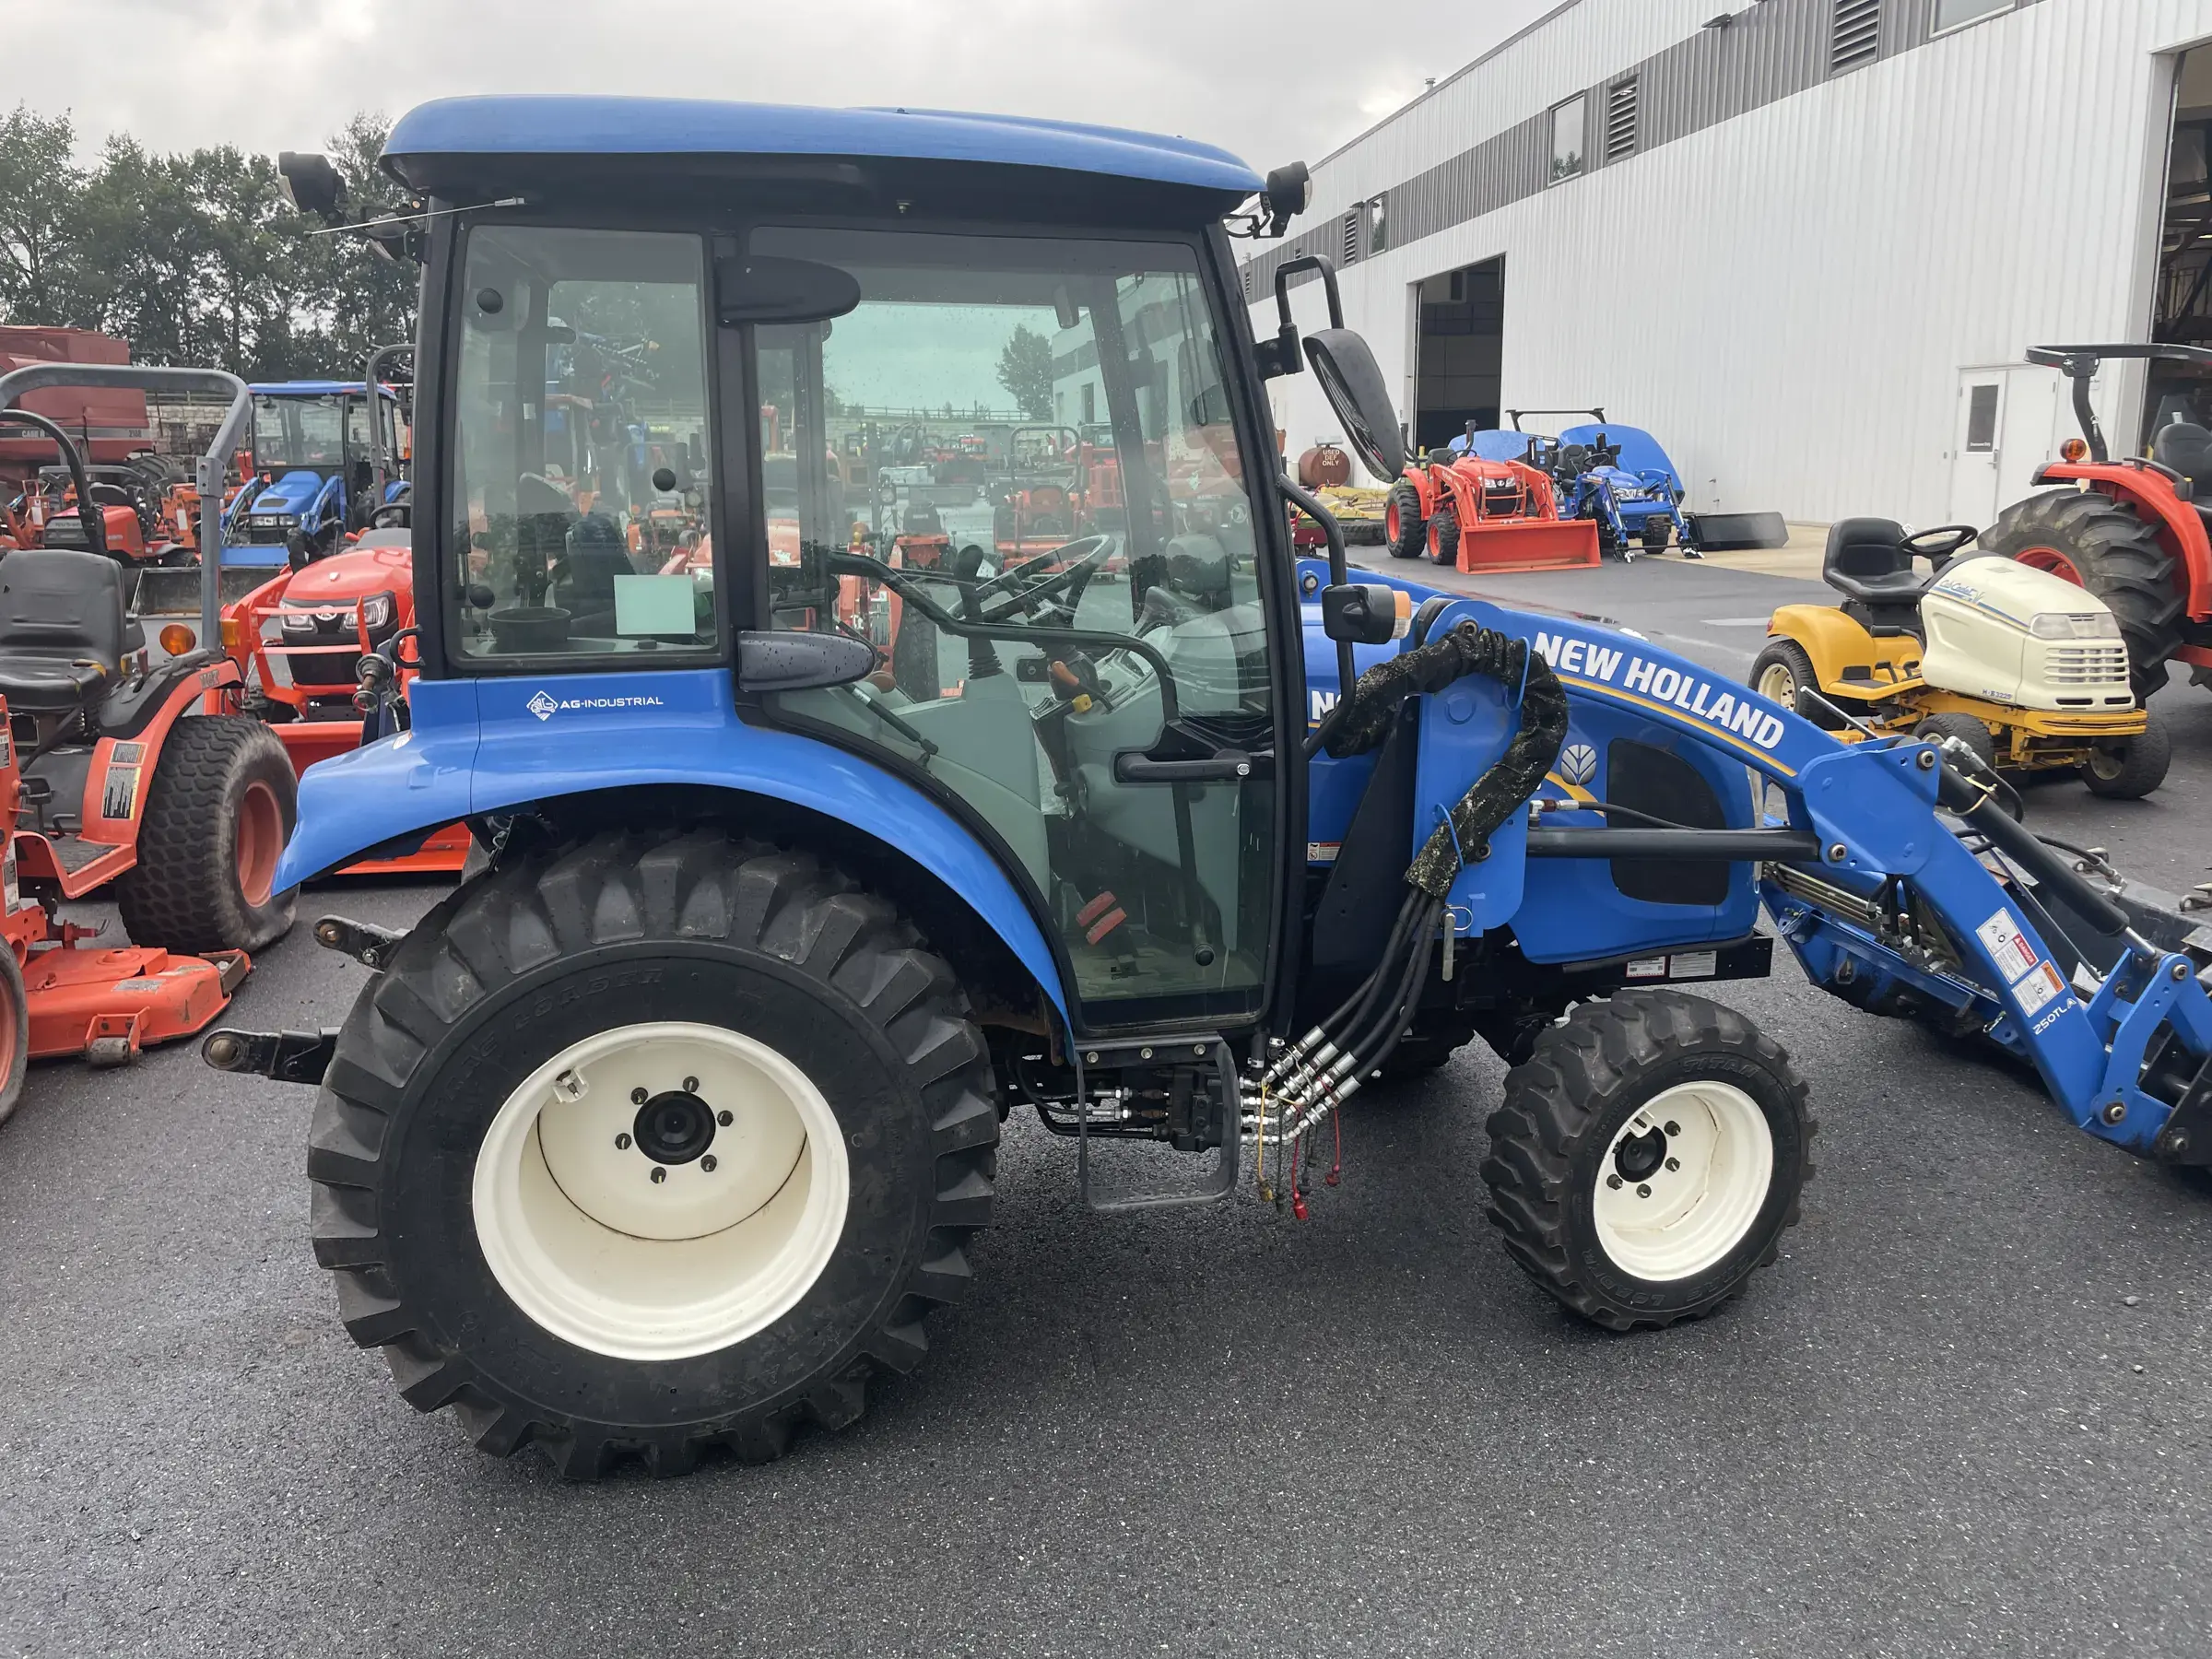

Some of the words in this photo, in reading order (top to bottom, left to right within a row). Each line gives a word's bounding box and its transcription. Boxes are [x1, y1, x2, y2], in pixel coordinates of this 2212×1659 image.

[559, 696, 664, 710] AG-INDUSTRIAL
[1534, 632, 1623, 683] NEW
[1623, 656, 1784, 749] HOLLAND
[2018, 941, 2035, 964] DANGER
[512, 967, 664, 1032] LOADER
[2032, 997, 2077, 1035] 250TLA
[1682, 1054, 1762, 1079] TITAN
